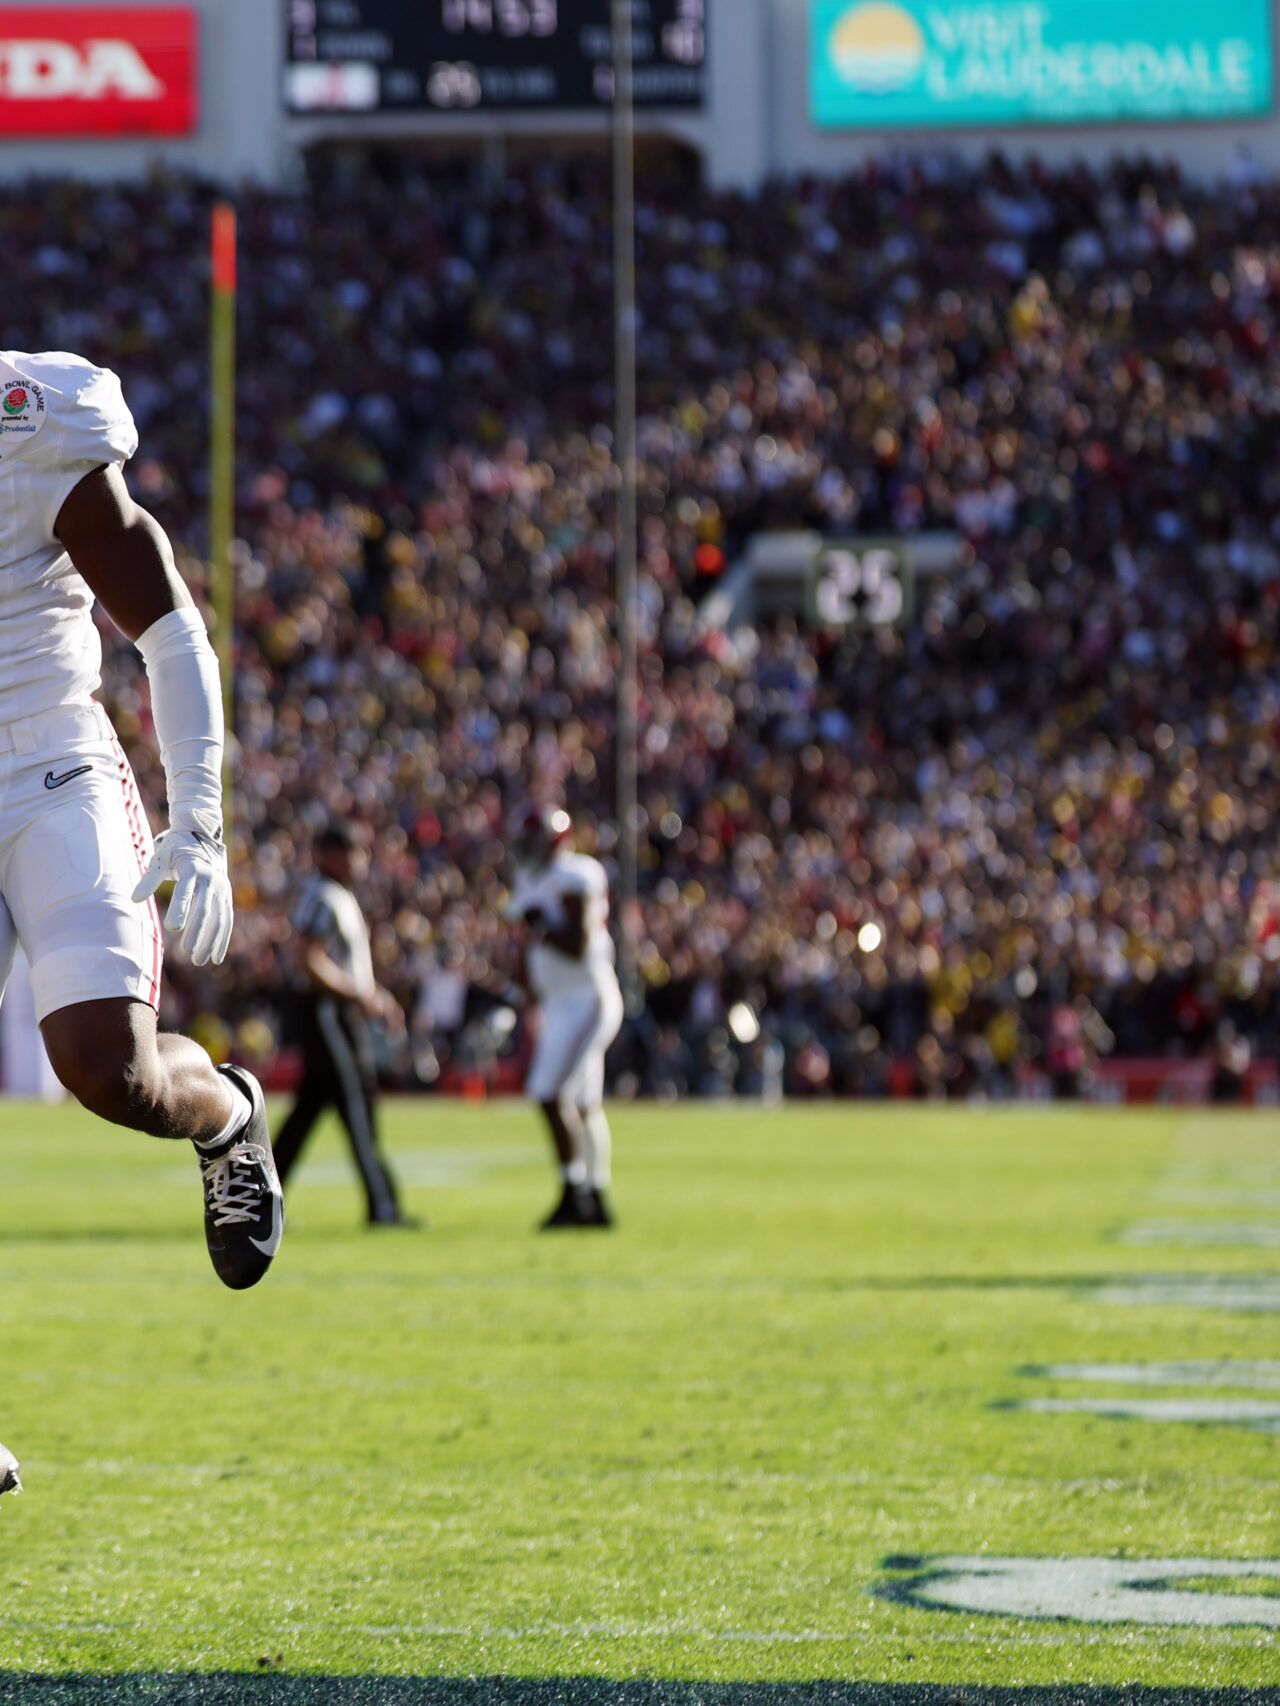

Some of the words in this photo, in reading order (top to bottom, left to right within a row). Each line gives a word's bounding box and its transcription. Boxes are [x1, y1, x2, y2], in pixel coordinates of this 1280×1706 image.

[926, 2, 1051, 52] VISIT
[926, 38, 1254, 99] LAUDERDALE
[5, 380, 31, 390] BOWL
[31, 385, 45, 412] GAME
[1, 414, 22, 422] presented
[4, 424, 36, 433] Prudential
[816, 548, 903, 625] 25
